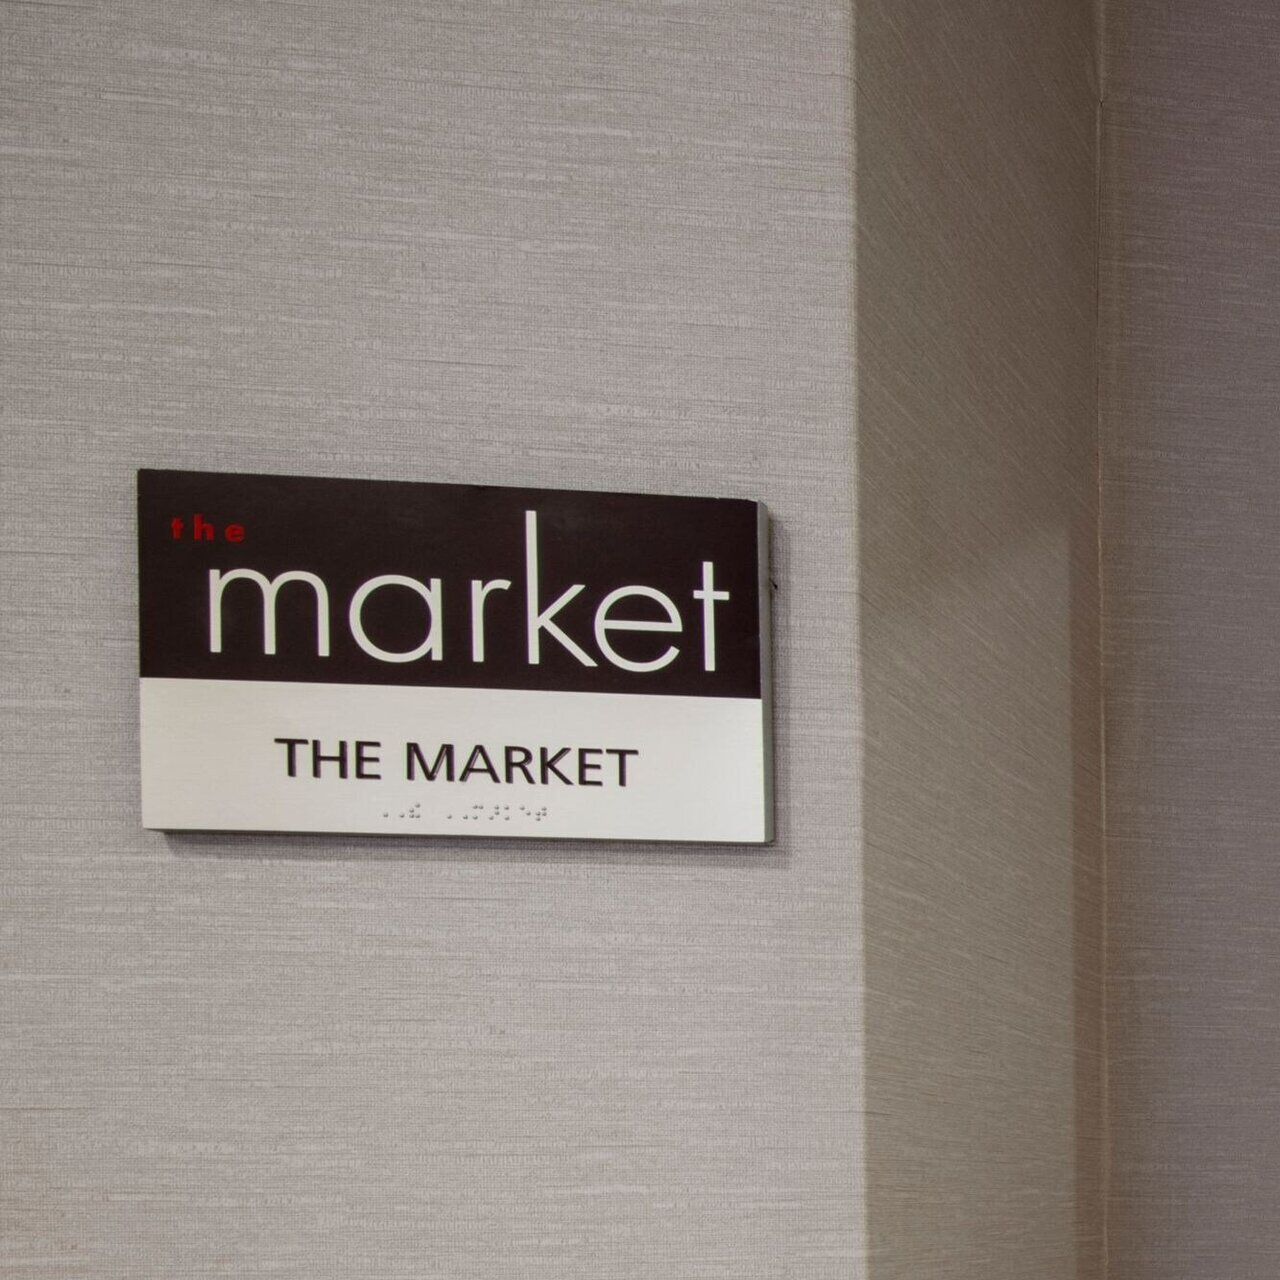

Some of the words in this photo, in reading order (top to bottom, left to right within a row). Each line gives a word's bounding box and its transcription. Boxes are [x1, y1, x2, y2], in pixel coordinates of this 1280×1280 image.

[170, 514, 246, 544] the
[208, 509, 730, 673] market
[274, 737, 382, 781] THE
[404, 741, 639, 788] MARKET
